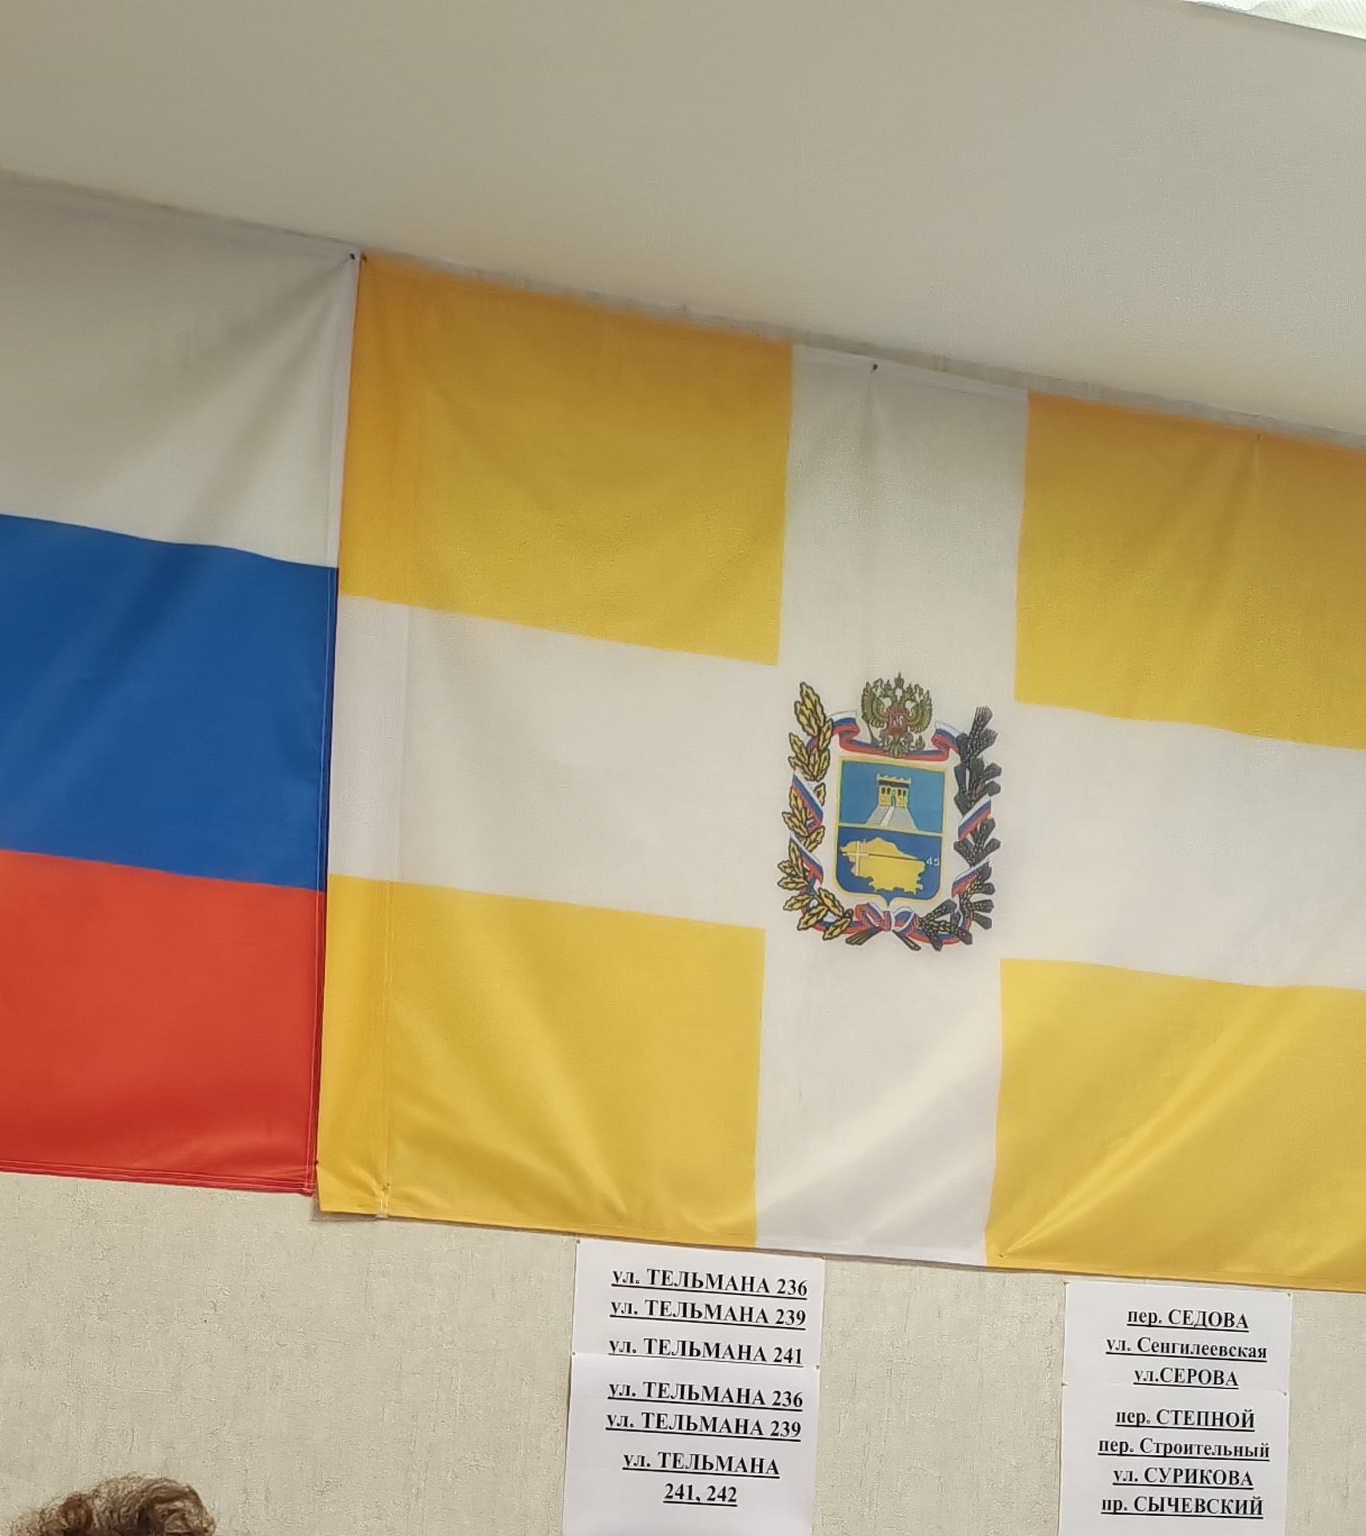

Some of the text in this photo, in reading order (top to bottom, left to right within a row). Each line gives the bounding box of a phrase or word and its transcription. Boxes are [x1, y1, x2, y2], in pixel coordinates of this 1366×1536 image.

[612, 1268, 808, 1296] ул. ТЕЛЬМАНА 236
[611, 1300, 806, 1326] ул. ТЕЛЬМАНА 239
[1127, 1309, 1249, 1329] пер. СЕДОВА
[609, 1338, 802, 1364] ул. ТЕЛЬМАНА 241
[1106, 1337, 1267, 1359] ул. Сенгилеевская
[1134, 1367, 1239, 1387] ул.СЕРОВА
[609, 1382, 803, 1408] ул. ТЕЛЬМАНА 236
[607, 1412, 801, 1437] ул. ТЕЛЬМАНА 239
[1115, 1408, 1255, 1428] пер. СТЕПНОЙ
[1098, 1438, 1270, 1458] пер. Строительный
[623, 1452, 780, 1475] ул. ТЕЛЬМАНА
[1113, 1467, 1254, 1487] ул. СУРИКОВА
[664, 1483, 738, 1503] 241, 242
[1101, 1496, 1264, 1516] пр. СЫЧЕВСКИЙ
